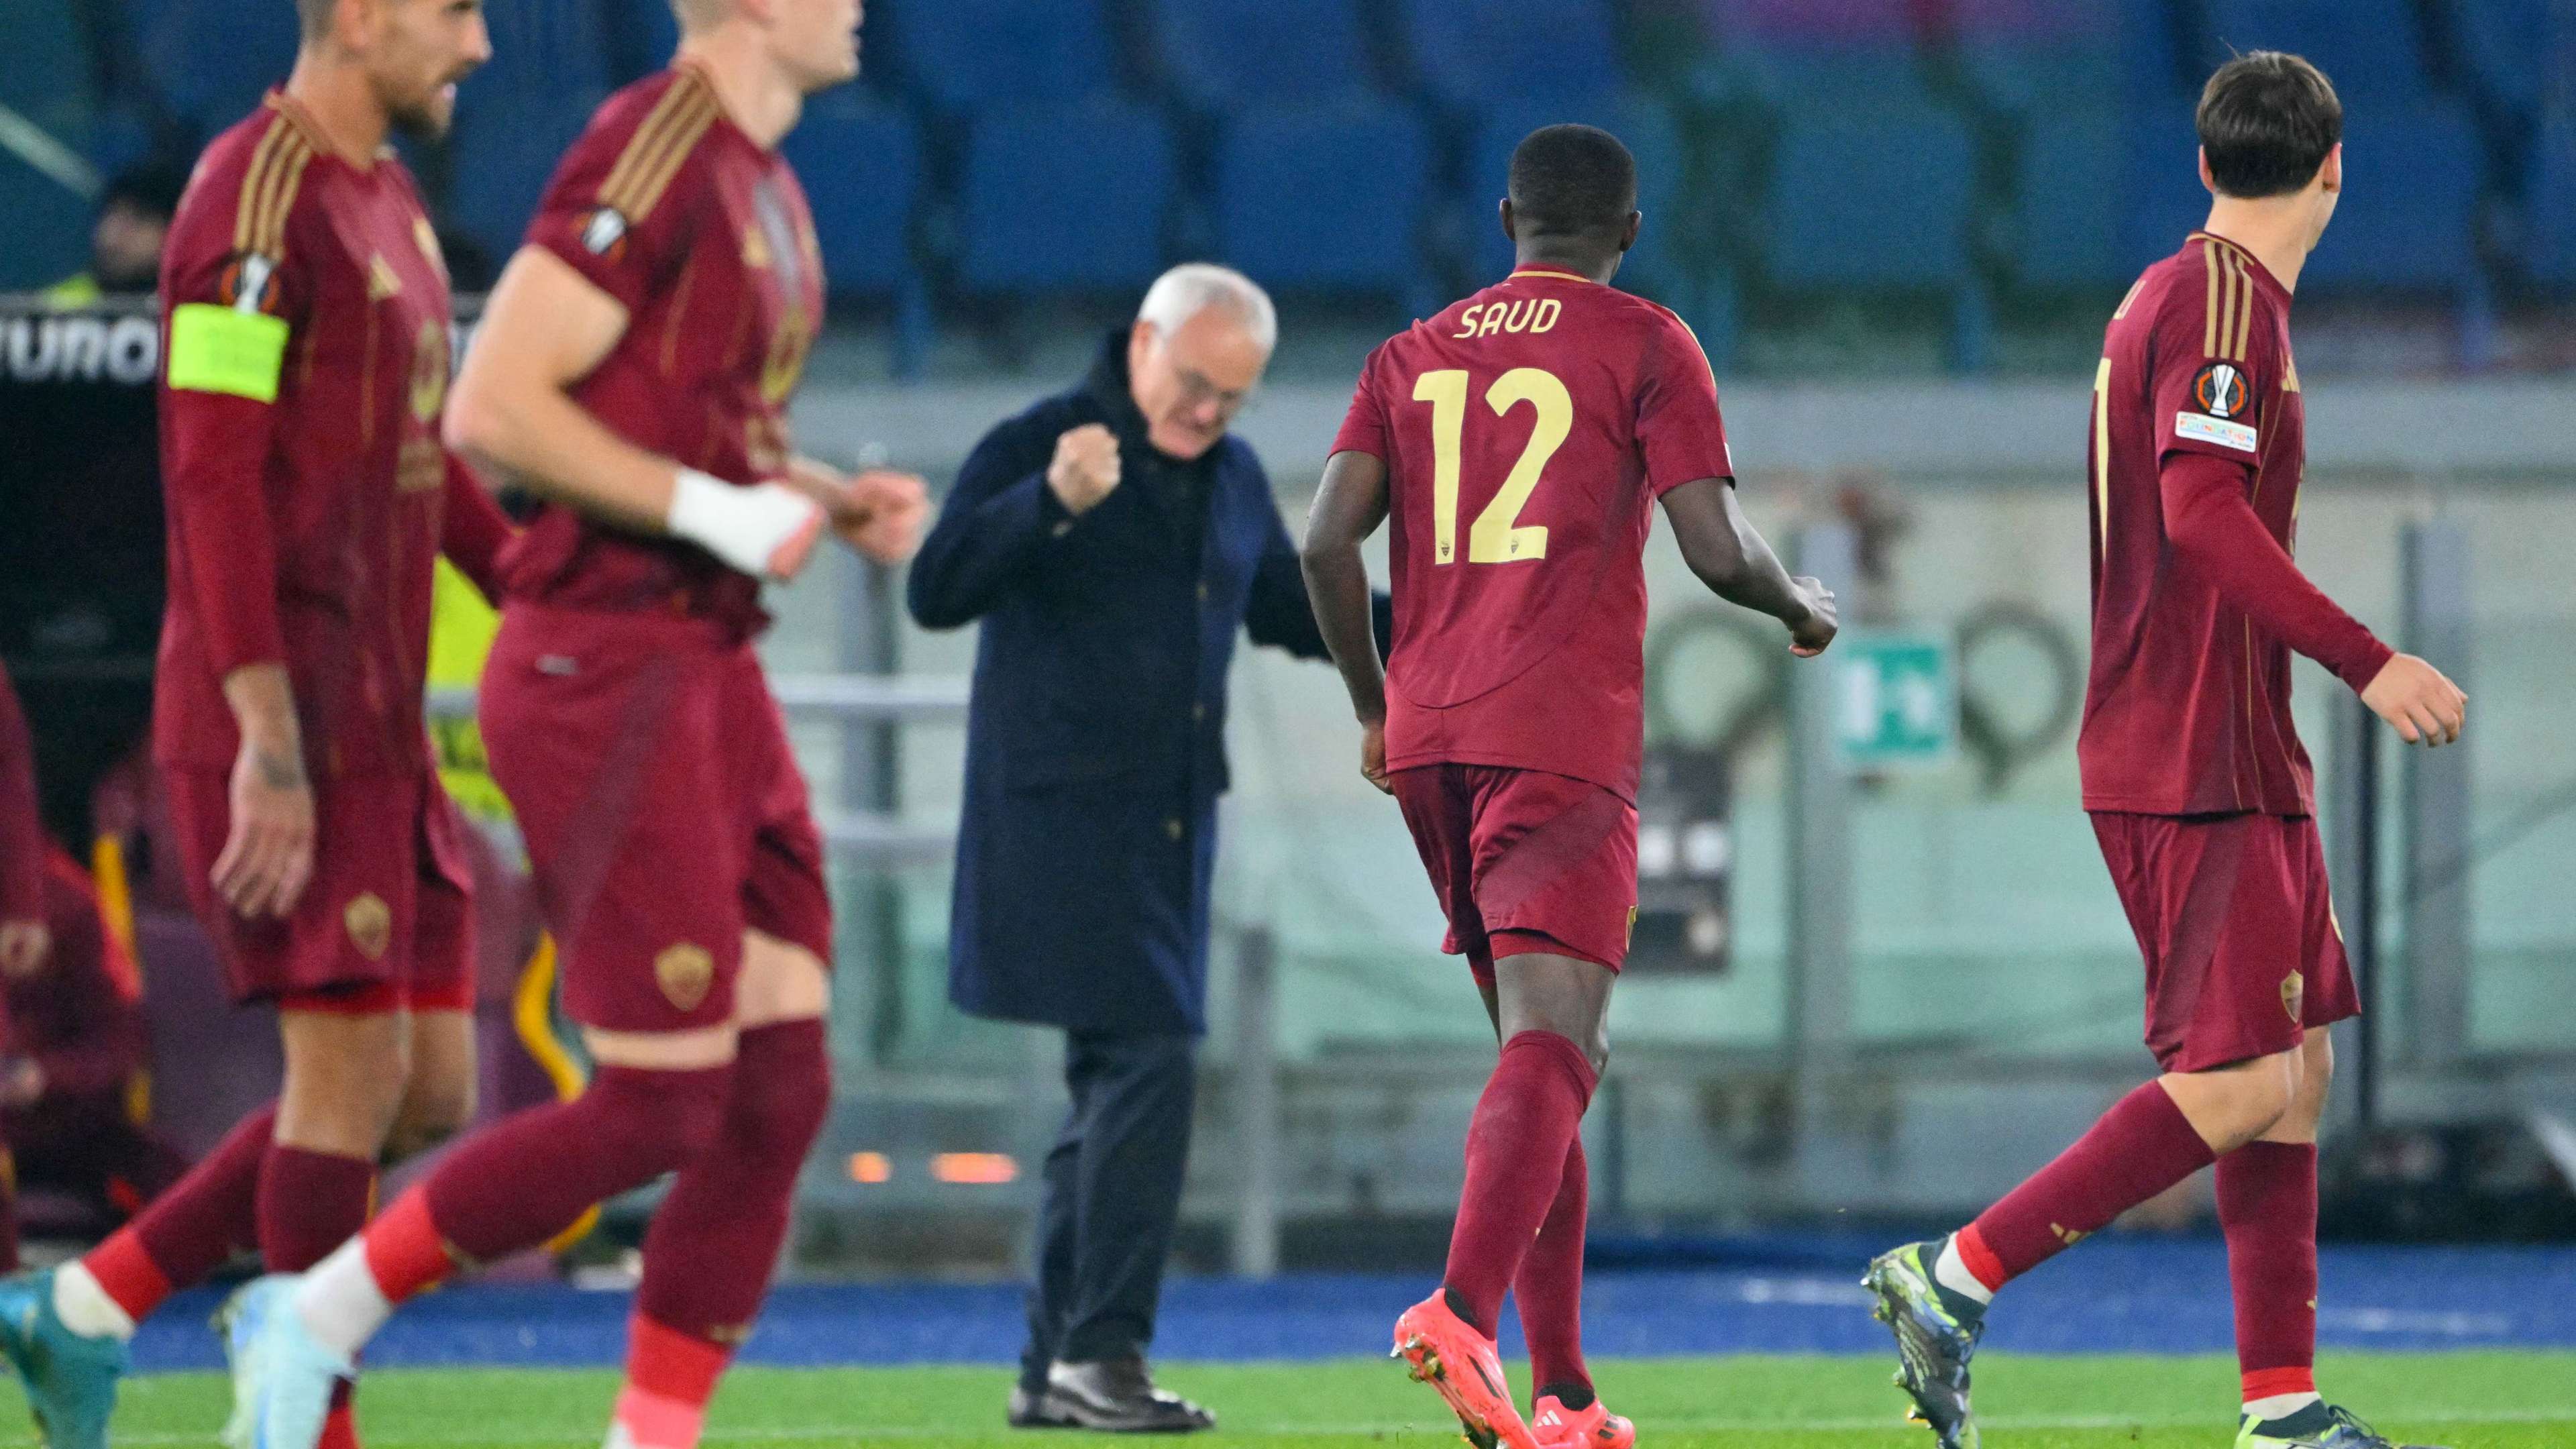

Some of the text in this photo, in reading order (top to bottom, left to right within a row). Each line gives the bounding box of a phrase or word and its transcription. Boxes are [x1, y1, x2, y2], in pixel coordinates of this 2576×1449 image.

[0, 317, 159, 384] URO
[1453, 298, 1562, 339] SAUD
[1413, 368, 1573, 565] 12
